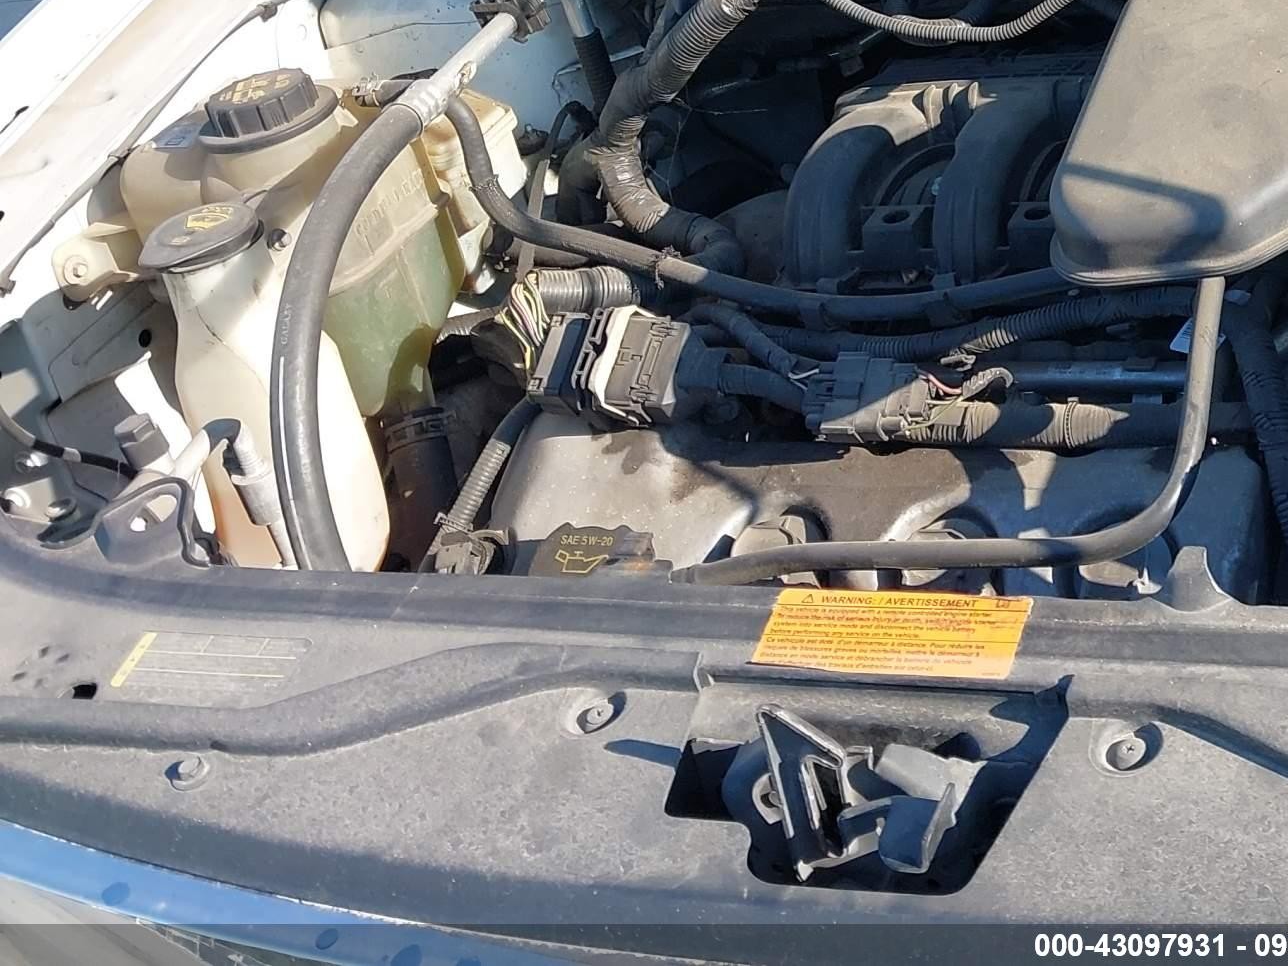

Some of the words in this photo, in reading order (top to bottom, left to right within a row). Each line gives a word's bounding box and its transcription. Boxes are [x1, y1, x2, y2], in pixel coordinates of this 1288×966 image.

[560, 534, 580, 545] SAE
[581, 535, 614, 547] 5W-20
[885, 597, 979, 607] AVERTISSEMENT
